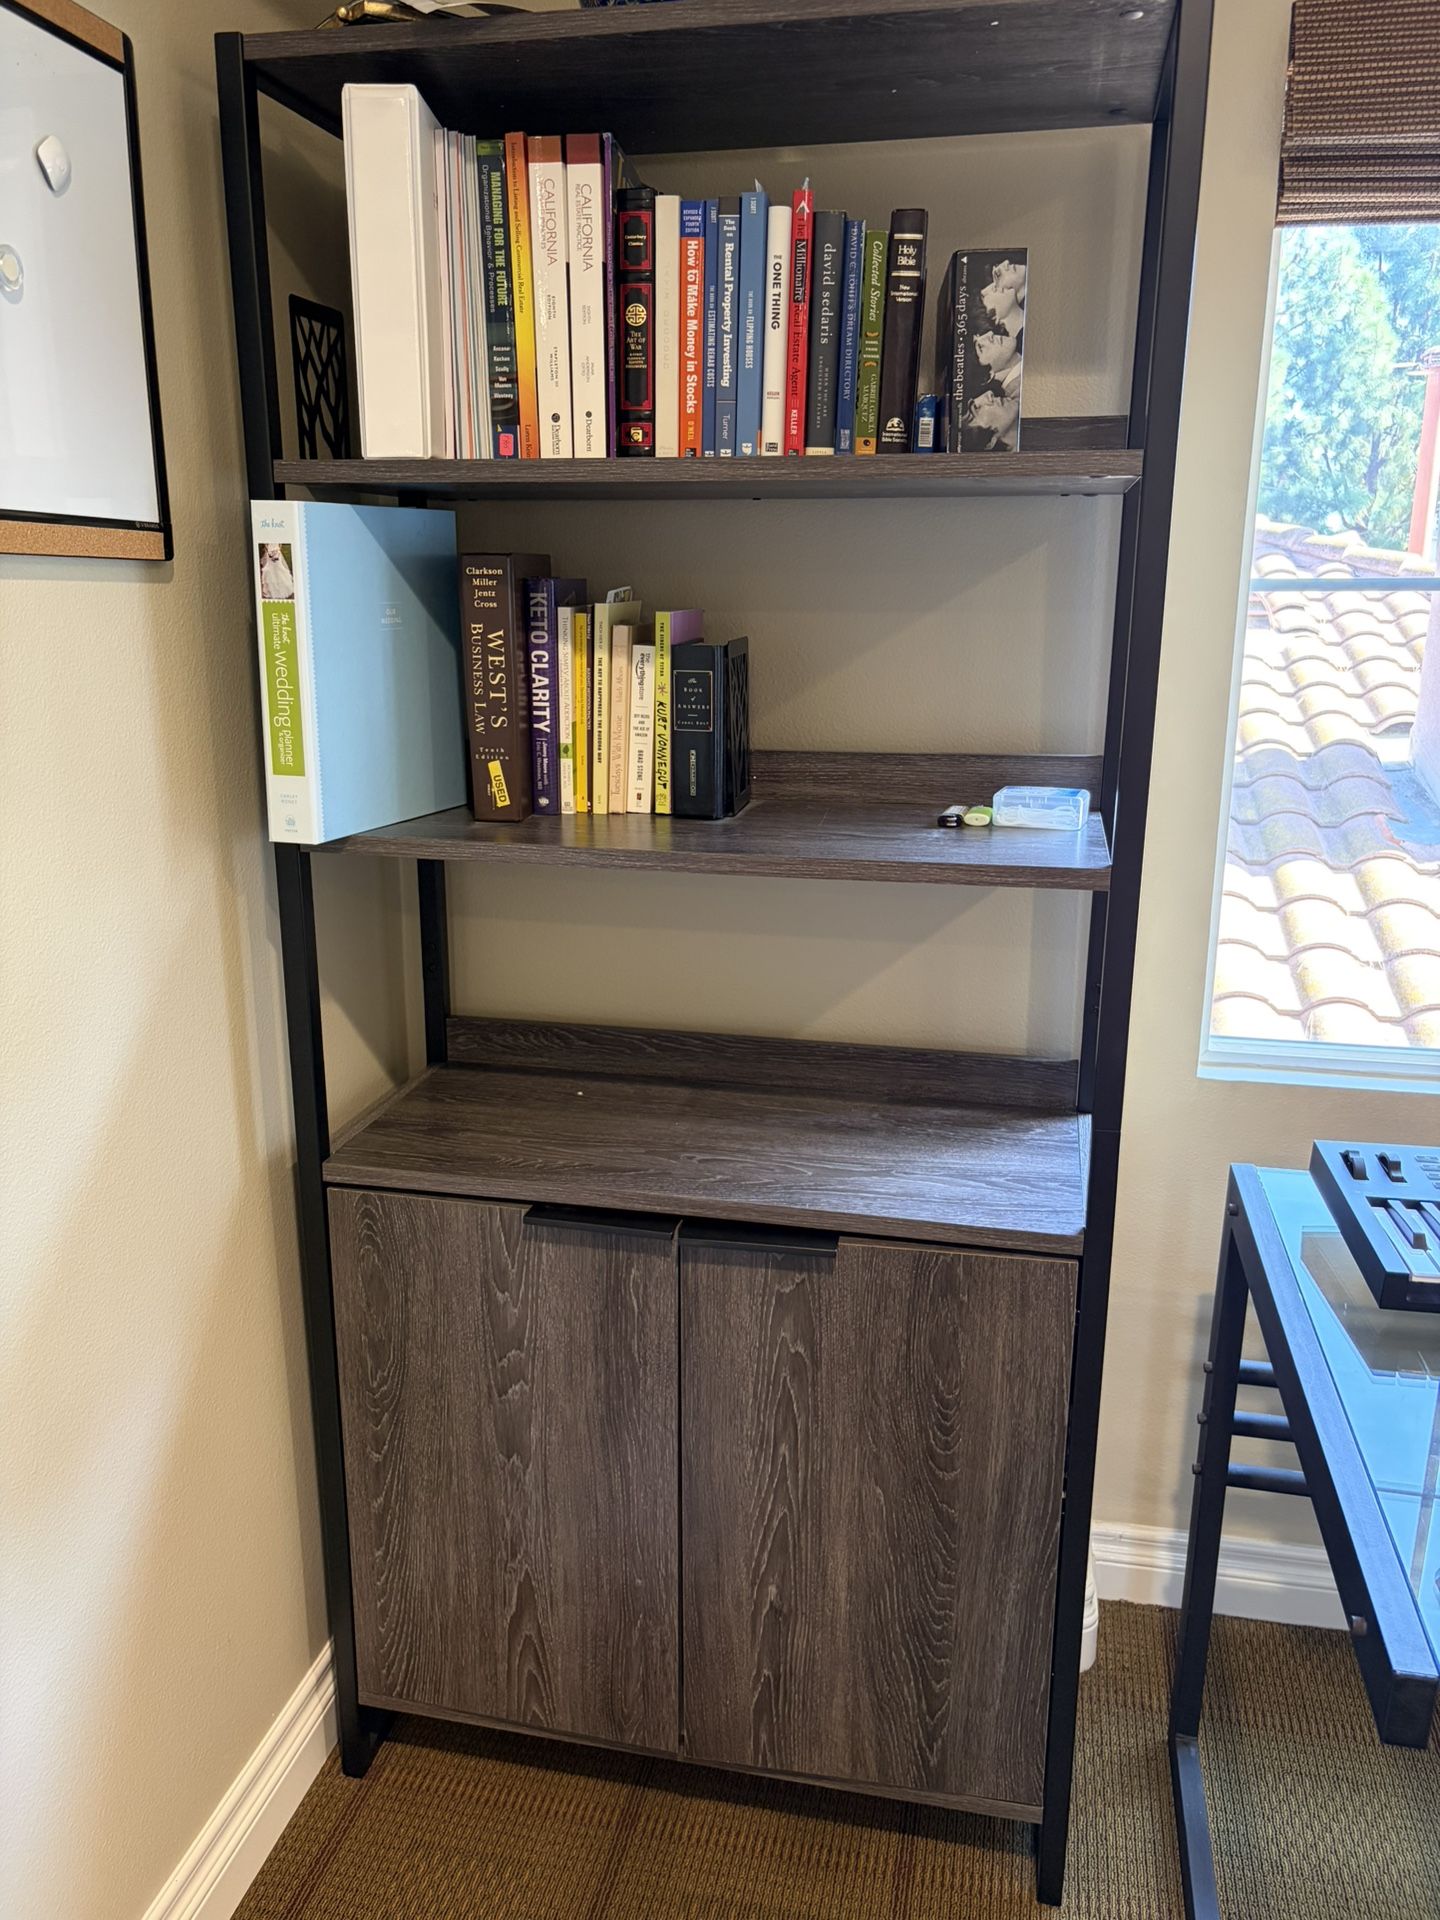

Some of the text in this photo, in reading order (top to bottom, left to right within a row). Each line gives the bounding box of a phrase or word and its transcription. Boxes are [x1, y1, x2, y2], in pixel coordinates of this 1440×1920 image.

[481, 164, 491, 222] Organizational
[490, 171, 508, 306] MANAGING FOR THE FUTURE
[543, 178, 558, 267] CALIFORNIA
[580, 183, 594, 273] CALIFORNIA
[484, 225, 493, 258] Behavior
[850, 227, 858, 259] DAVID
[898, 244, 917, 256] Holy
[794, 241, 807, 301] Millionaire
[897, 256, 916, 265] Bible
[771, 262, 782, 330] ONE THING
[820, 243, 837, 344] david sedaris
[869, 240, 883, 322] Collected Stories
[684, 240, 699, 414] How to Make Money in Stocks
[707, 310, 716, 346] ESTIMATING
[720, 243, 735, 388] Rental Property Investing
[746, 316, 754, 344] FLIPPING
[793, 305, 804, 328] Real
[845, 312, 855, 346] DREAM
[707, 348, 715, 367] REHAB
[745, 345, 753, 368] HOUSES
[791, 332, 803, 363] Estate
[952, 285, 970, 400] the beatles 365 days
[706, 369, 714, 387] COSTS
[791, 366, 801, 396] Agent
[842, 349, 853, 401] DIRECTORY
[585, 419, 593, 452] Dearborn
[722, 414, 730, 440] Turner
[790, 409, 798, 435] KELLER
[465, 567, 503, 575] Clarkson
[472, 578, 497, 586] Miller
[474, 589, 496, 599] Jentz
[474, 600, 498, 608] Cross
[281, 612, 292, 645] the knot
[561, 616, 569, 650] THINKING
[470, 623, 487, 735] BUSINESS LAW
[486, 629, 508, 728] WEST'S
[529, 592, 551, 733] KETO CLARITY
[271, 612, 295, 767] ultimate wedding planner
[612, 744, 621, 761] With
[656, 700, 669, 789] KURT VONNEGUT
[493, 774, 507, 802] USED
[611, 763, 623, 795] Tuesdays
